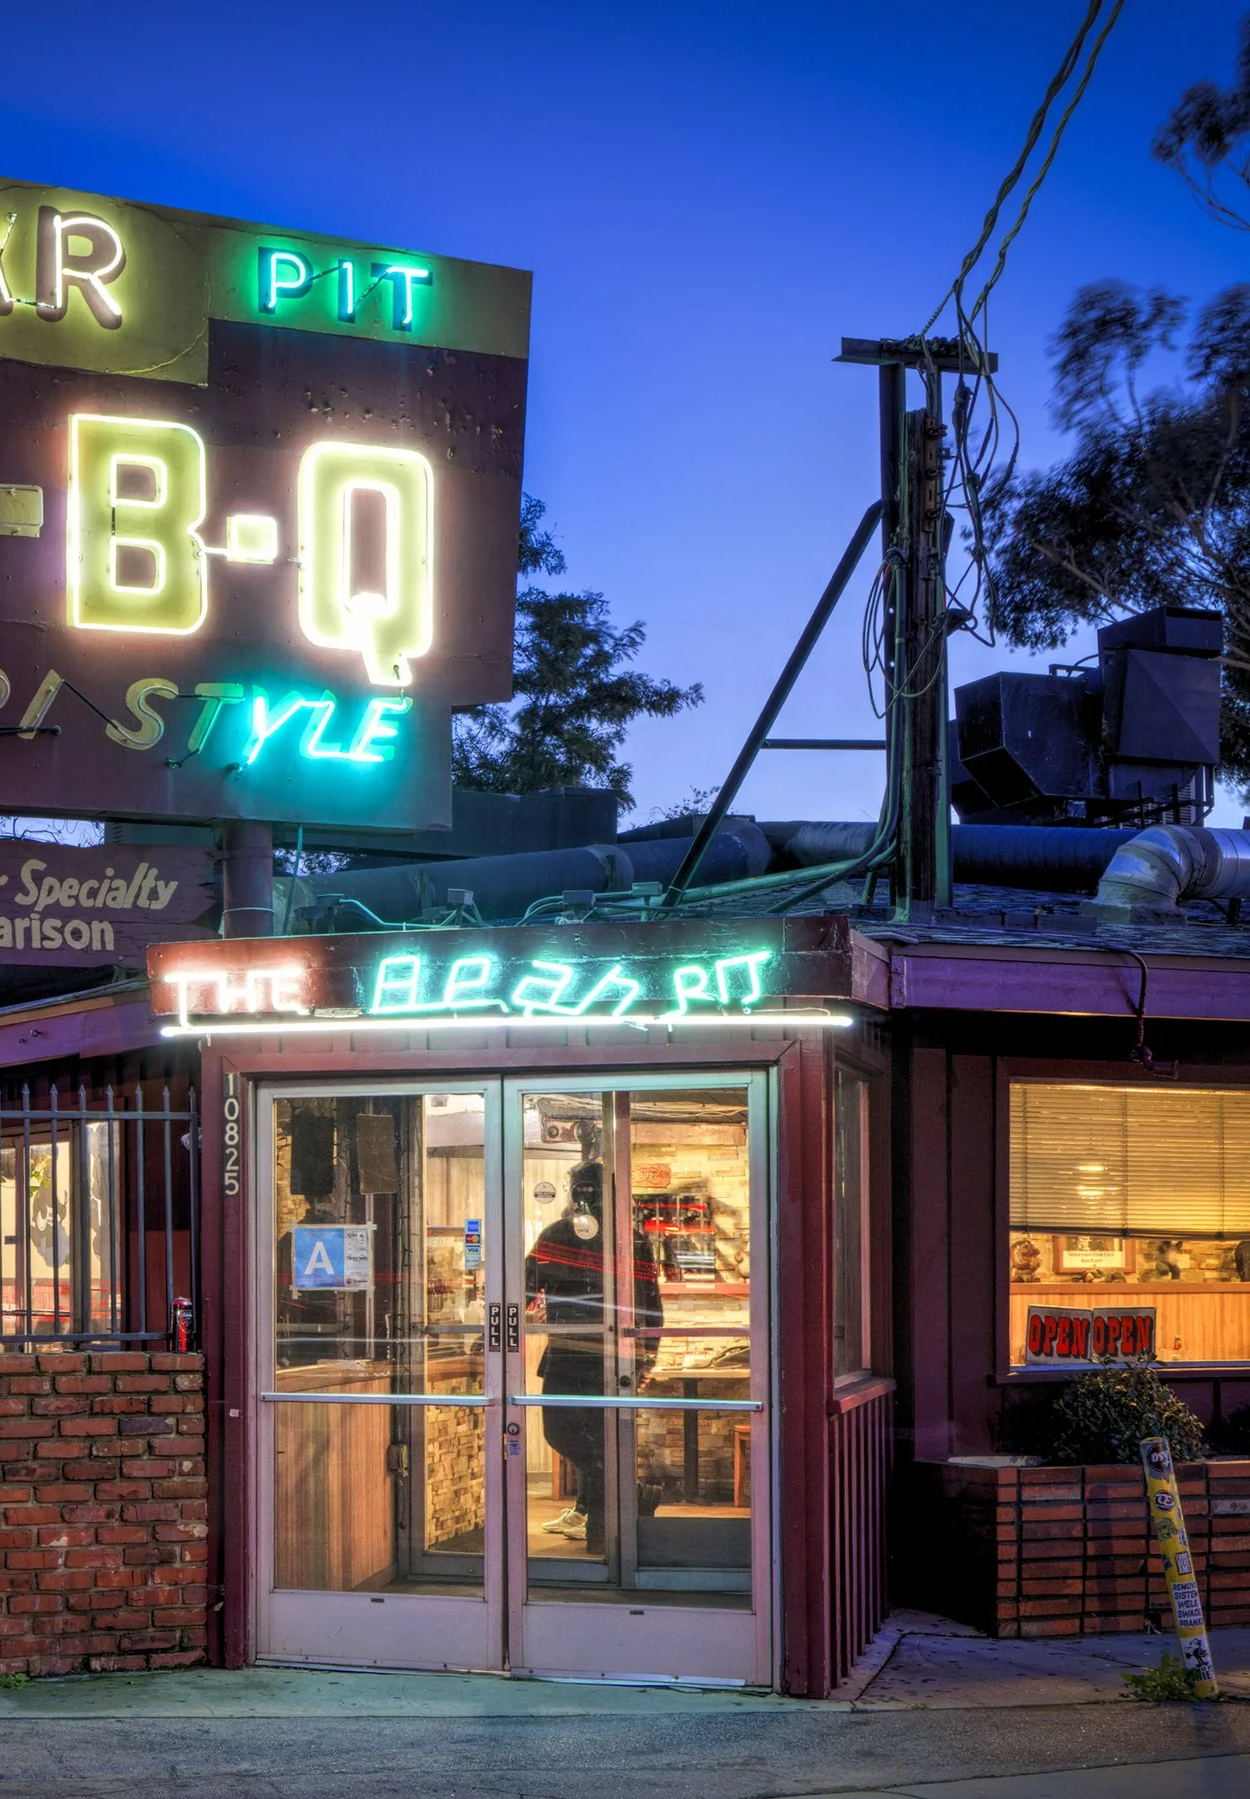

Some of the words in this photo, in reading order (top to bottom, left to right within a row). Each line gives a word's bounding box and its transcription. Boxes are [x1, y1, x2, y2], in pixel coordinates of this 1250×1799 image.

[258, 246, 433, 332] PIT
[105, 677, 413, 770] STYLE
[14, 858, 178, 911] Specialty
[164, 968, 305, 1028] THE
[224, 1073, 239, 1196] 10825
[304, 1241, 335, 1275] A
[491, 1307, 499, 1346] PULL
[509, 1307, 517, 1347] PULL
[1029, 1314, 1090, 1359] OPEN
[1093, 1315, 1153, 1358] OPEN
